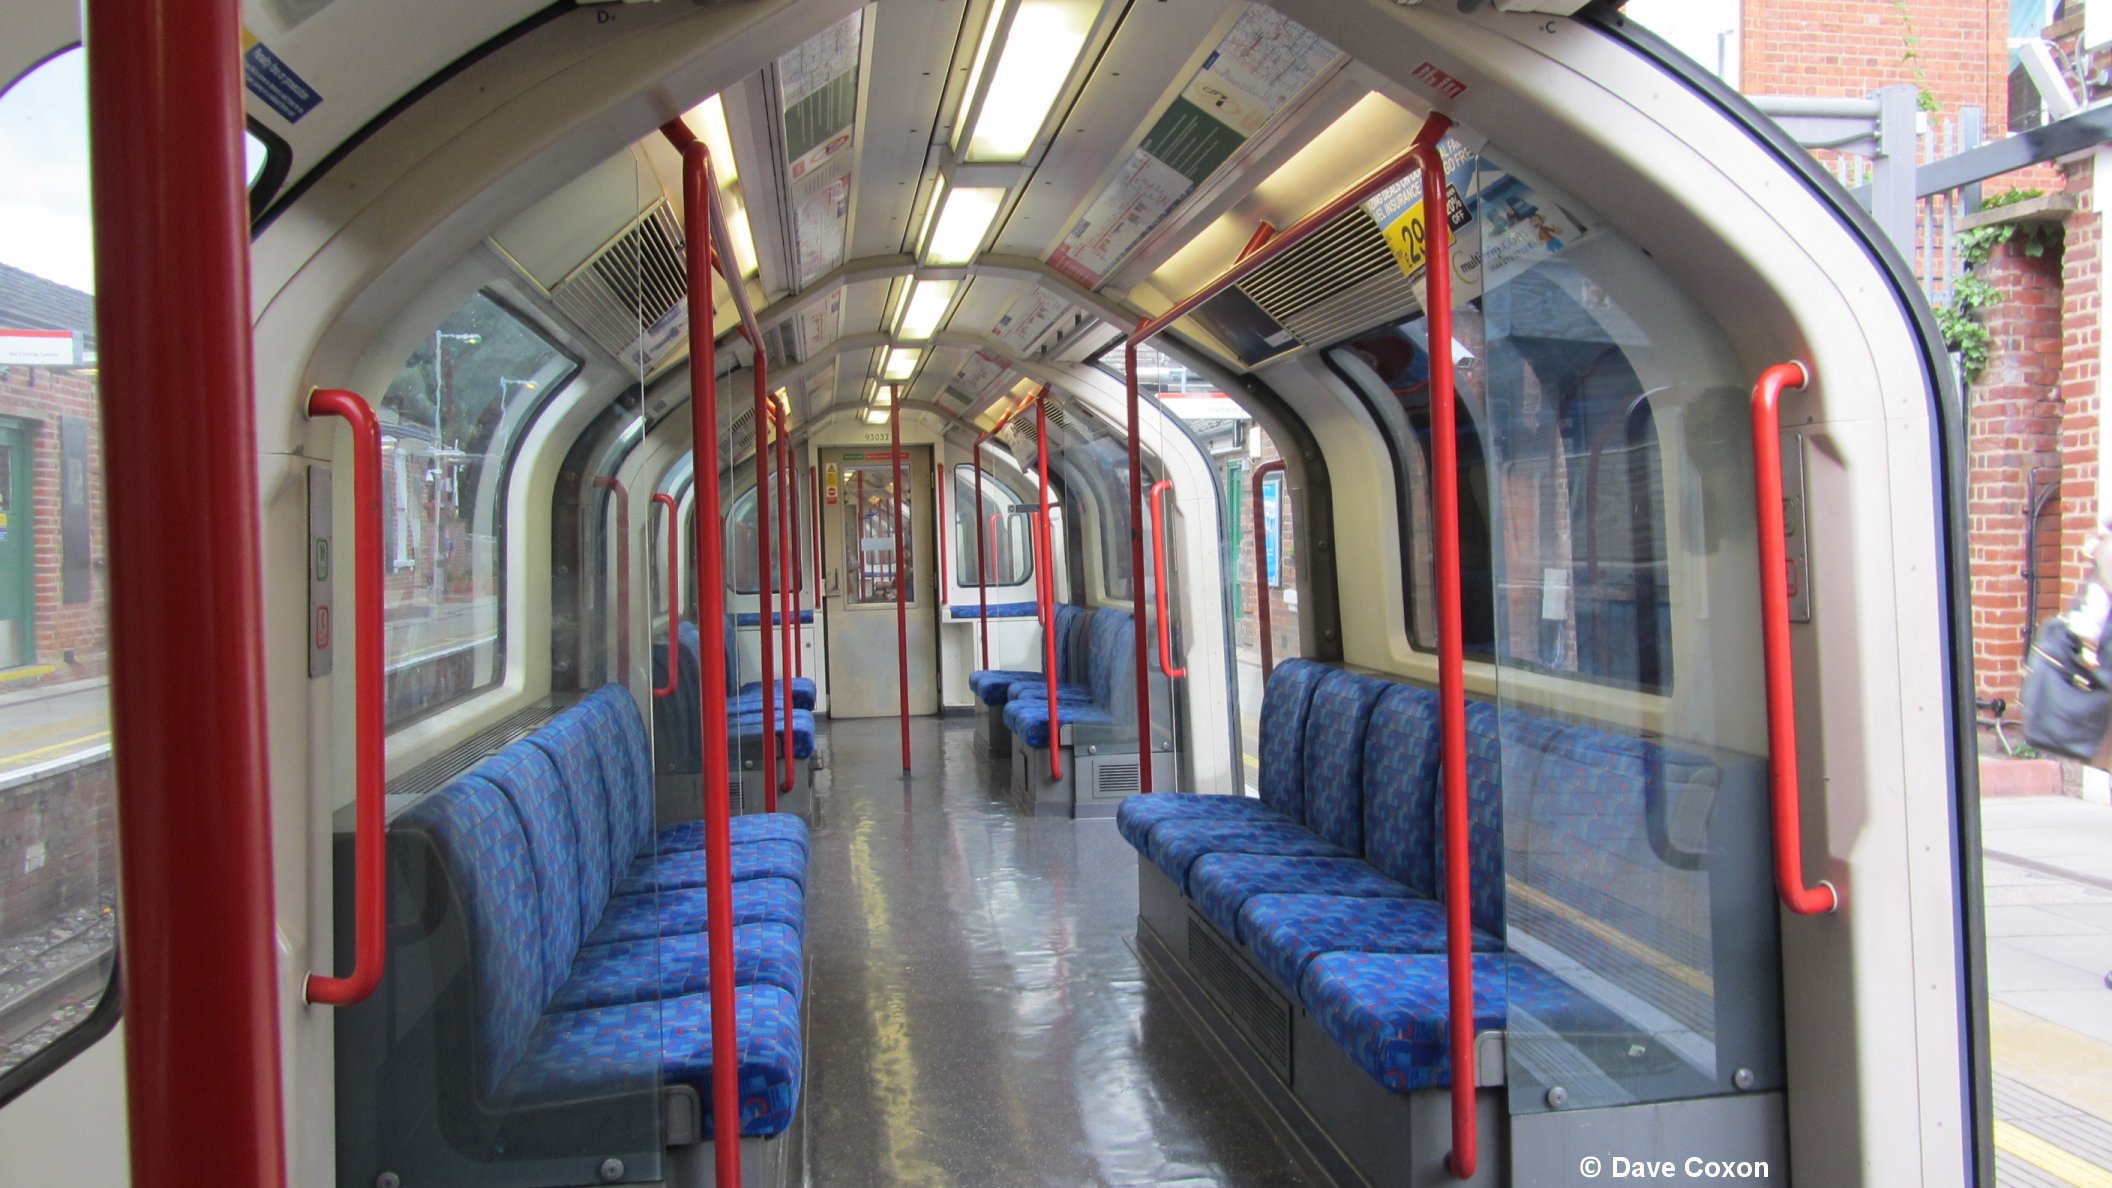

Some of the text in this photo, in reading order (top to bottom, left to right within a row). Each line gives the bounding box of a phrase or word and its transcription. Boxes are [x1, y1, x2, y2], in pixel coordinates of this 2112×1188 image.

[1384, 181, 1421, 215] INSURANCE
[1452, 211, 1465, 224] OFF
[865, 433, 889, 441] 93032
